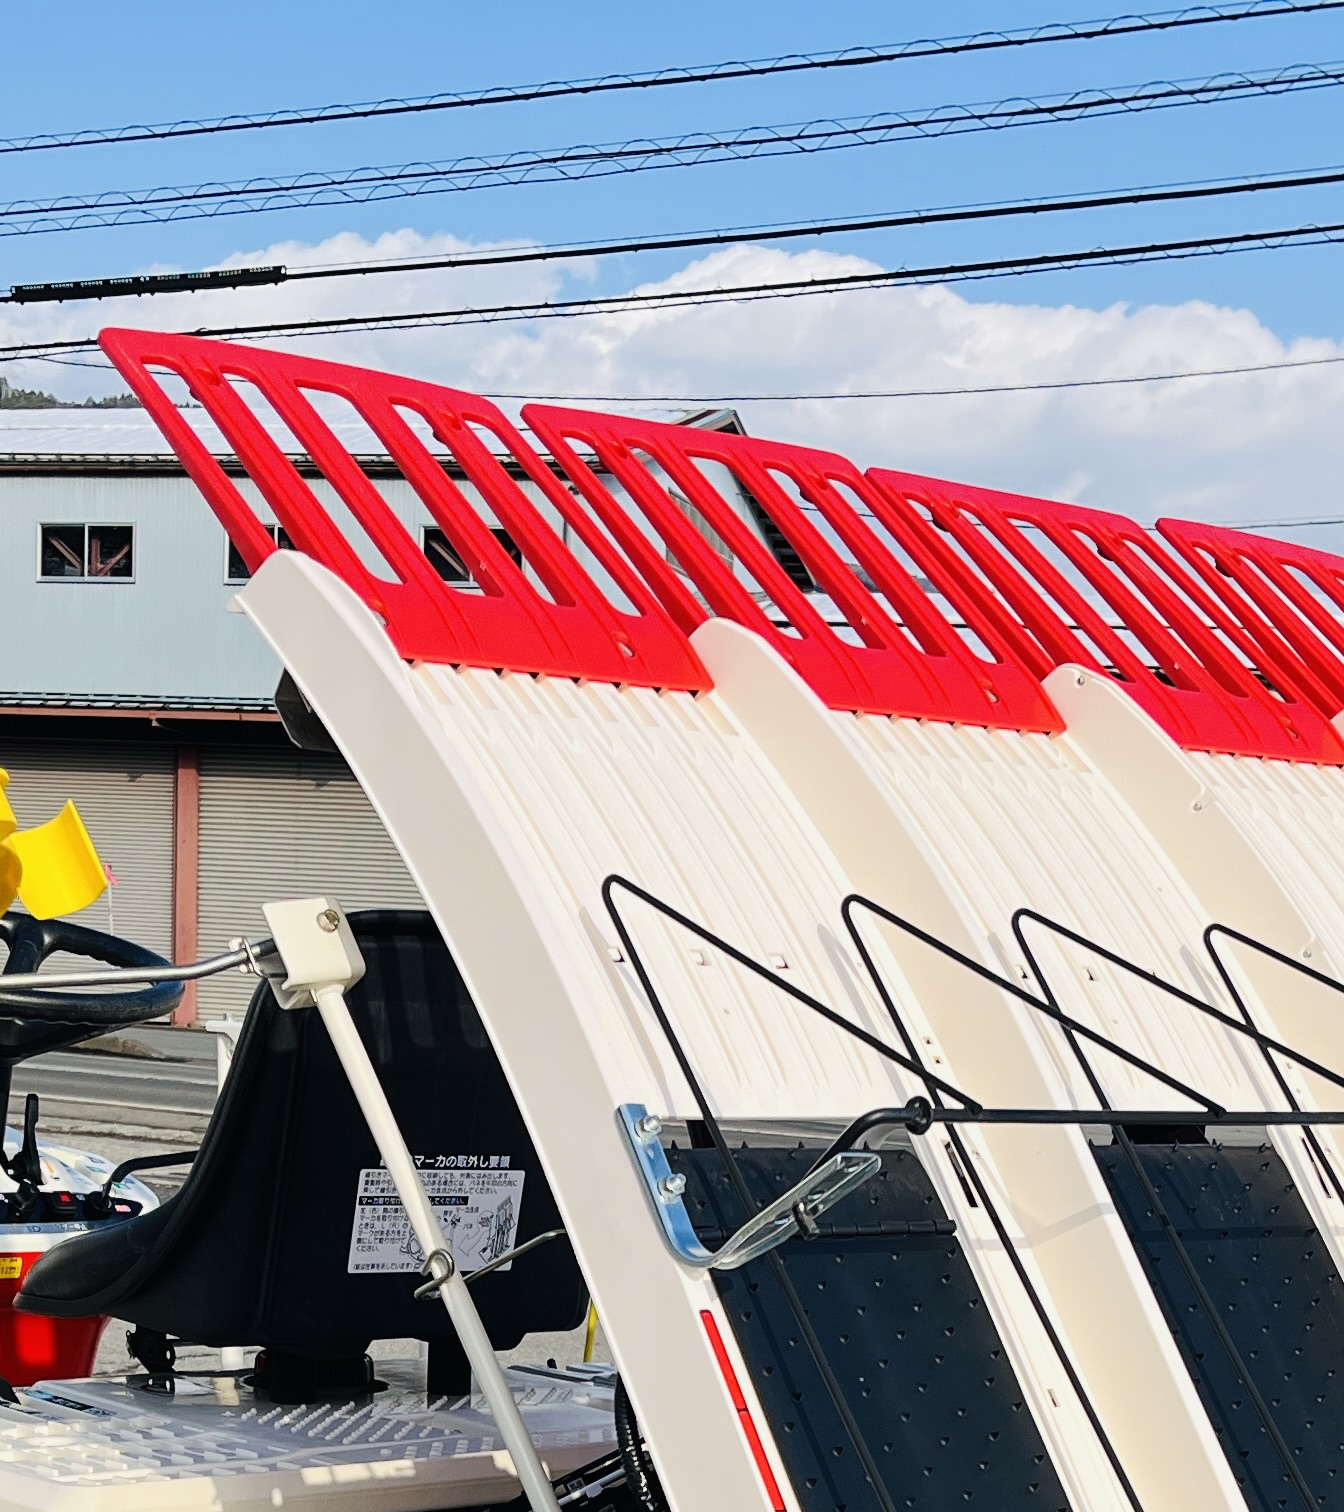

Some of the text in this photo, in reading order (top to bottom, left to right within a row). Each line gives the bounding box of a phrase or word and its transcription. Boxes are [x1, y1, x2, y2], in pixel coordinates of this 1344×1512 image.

[380, 1154, 511, 1168] マーカの取外し要領
